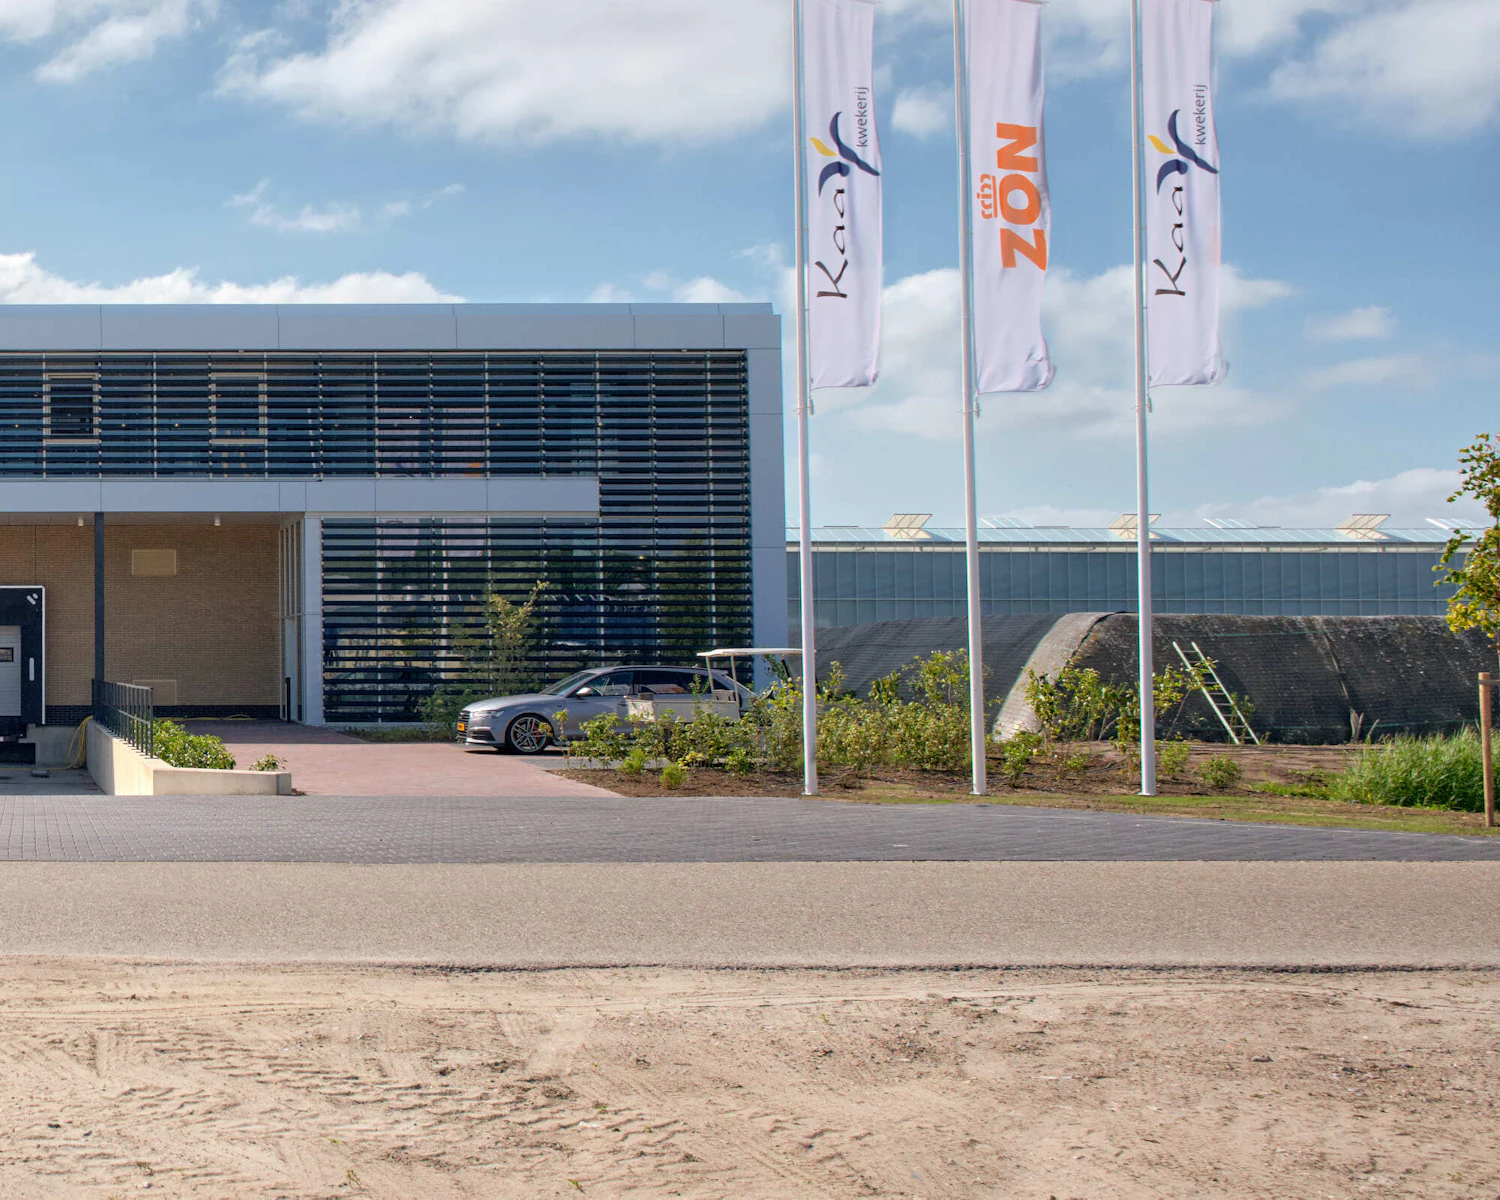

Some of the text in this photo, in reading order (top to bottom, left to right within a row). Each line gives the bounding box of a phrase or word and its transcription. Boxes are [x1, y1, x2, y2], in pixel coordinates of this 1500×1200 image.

[854, 87, 870, 148] kwekerij
[1193, 84, 1208, 145] kwekerij
[996, 121, 1048, 271] ZON
